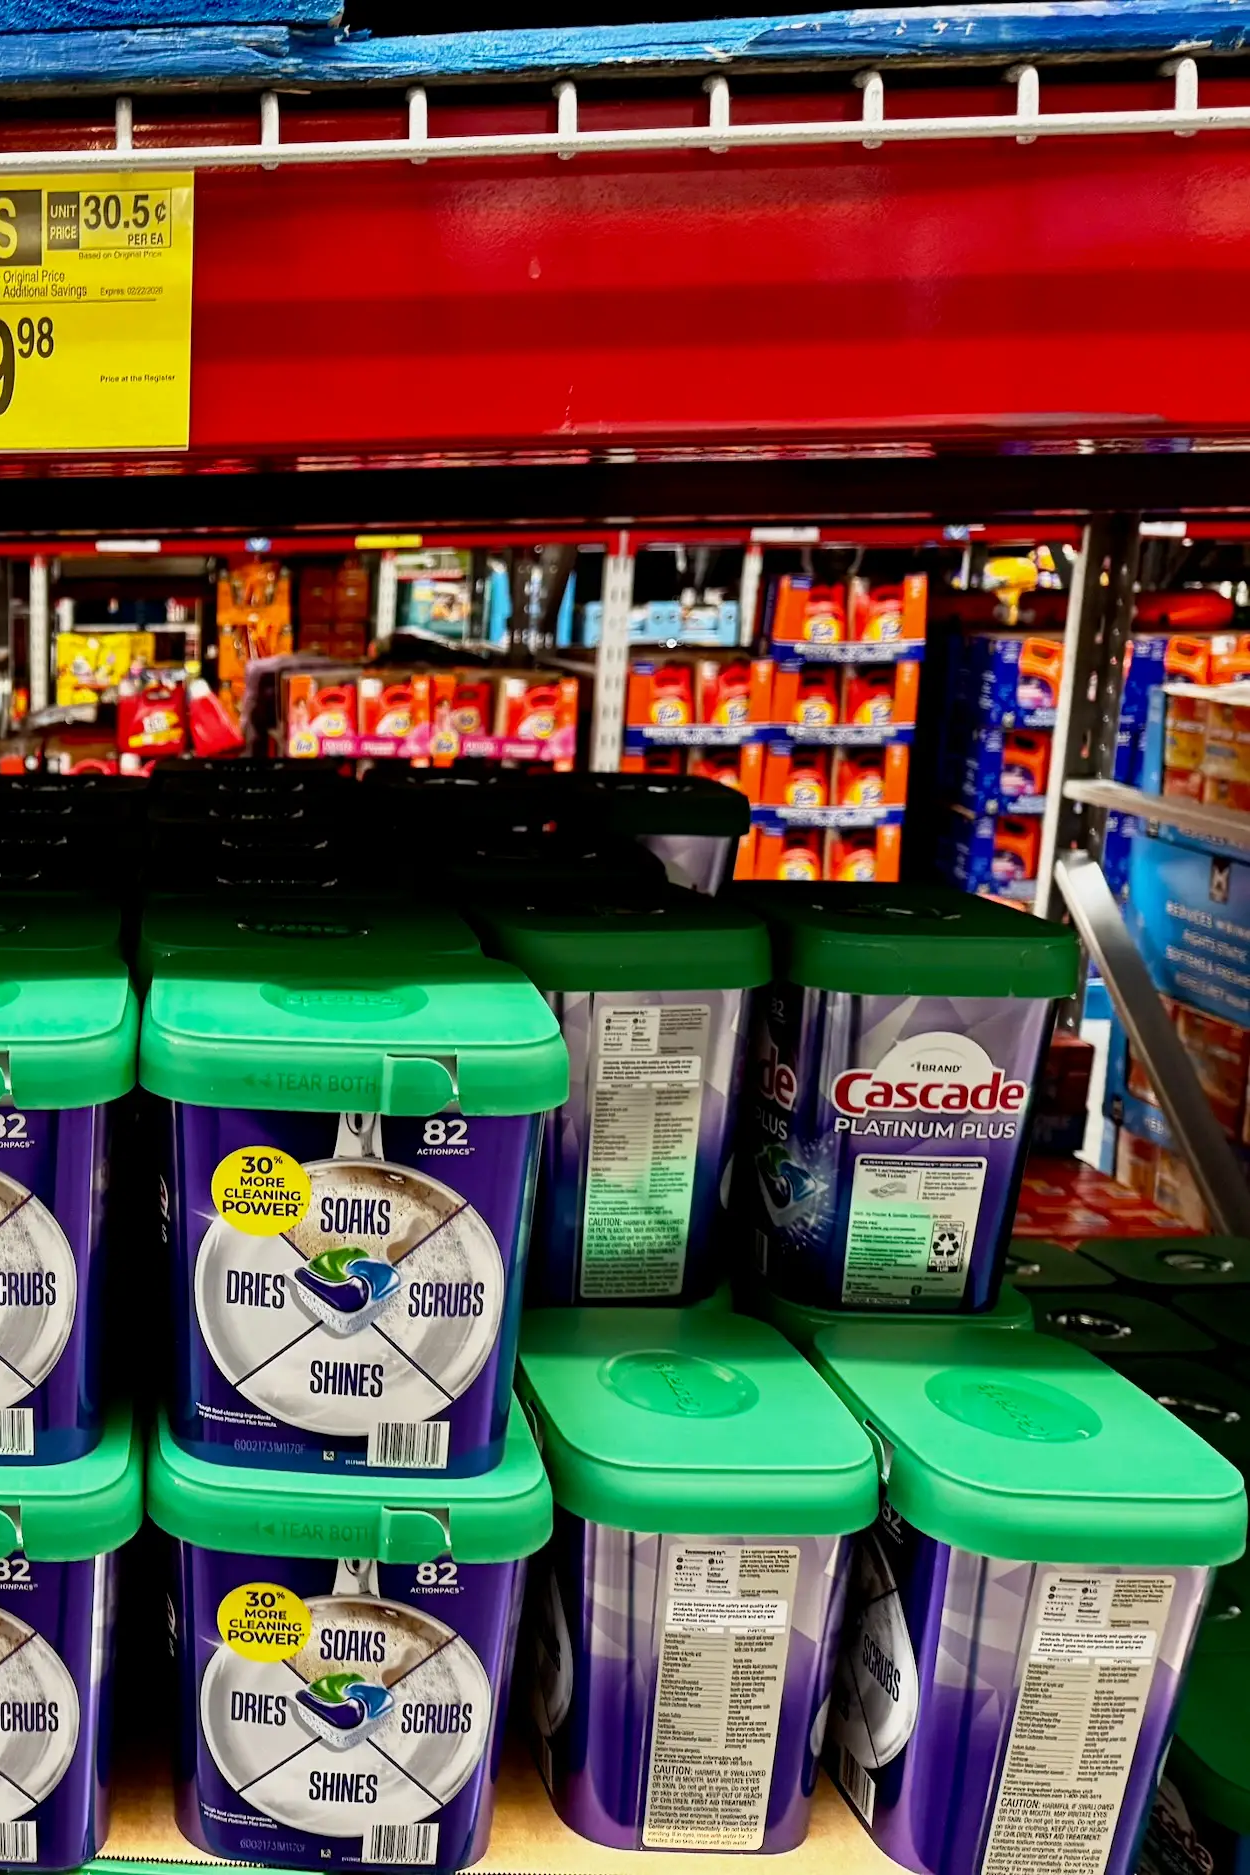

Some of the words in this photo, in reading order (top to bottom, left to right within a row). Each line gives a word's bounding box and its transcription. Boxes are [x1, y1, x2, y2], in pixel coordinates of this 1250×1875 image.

[50, 204, 77, 218] UNIT
[50, 224, 77, 240] PRICE
[127, 233, 148, 246] PER
[150, 233, 164, 245] EA
[78, 251, 102, 260] Based
[103, 252, 112, 260] on
[113, 250, 142, 261] Original
[143, 250, 163, 259] Price
[3, 269, 40, 287] Original
[41, 269, 66, 284] Price
[3, 284, 50, 298] Additional
[51, 284, 88, 300] Savings
[99, 374, 120, 384] Price
[121, 374, 129, 383] at
[130, 374, 142, 383] the
[143, 373, 176, 383] Register
[276, 1073, 322, 1092] TEAR
[329, 1075, 379, 1094] BOTH
[833, 1071, 1025, 1114] Cascade
[422, 1119, 469, 1146] 82
[834, 1119, 954, 1139] PLATINUM
[960, 1121, 1017, 1139] PLUS
[240, 1176, 286, 1189] MORE
[223, 1187, 302, 1201] CLEANING
[320, 1196, 391, 1236] SOAKS
[226, 1270, 285, 1309] DRIES
[407, 1282, 485, 1318] SCRUBS
[309, 1360, 384, 1398] SHINES
[415, 1562, 459, 1586] 82
[244, 1609, 288, 1621] MORE
[228, 1619, 303, 1633] CLEANING
[319, 1629, 387, 1663] SOAKS
[862, 1632, 901, 1703] SCRUBS
[230, 1691, 287, 1726] DRIES
[401, 1703, 473, 1734] SCRUBS
[653, 1764, 693, 1776] CAUTION:
[308, 1770, 379, 1804] SHINES
[1000, 1797, 1041, 1809] CAUTION:
